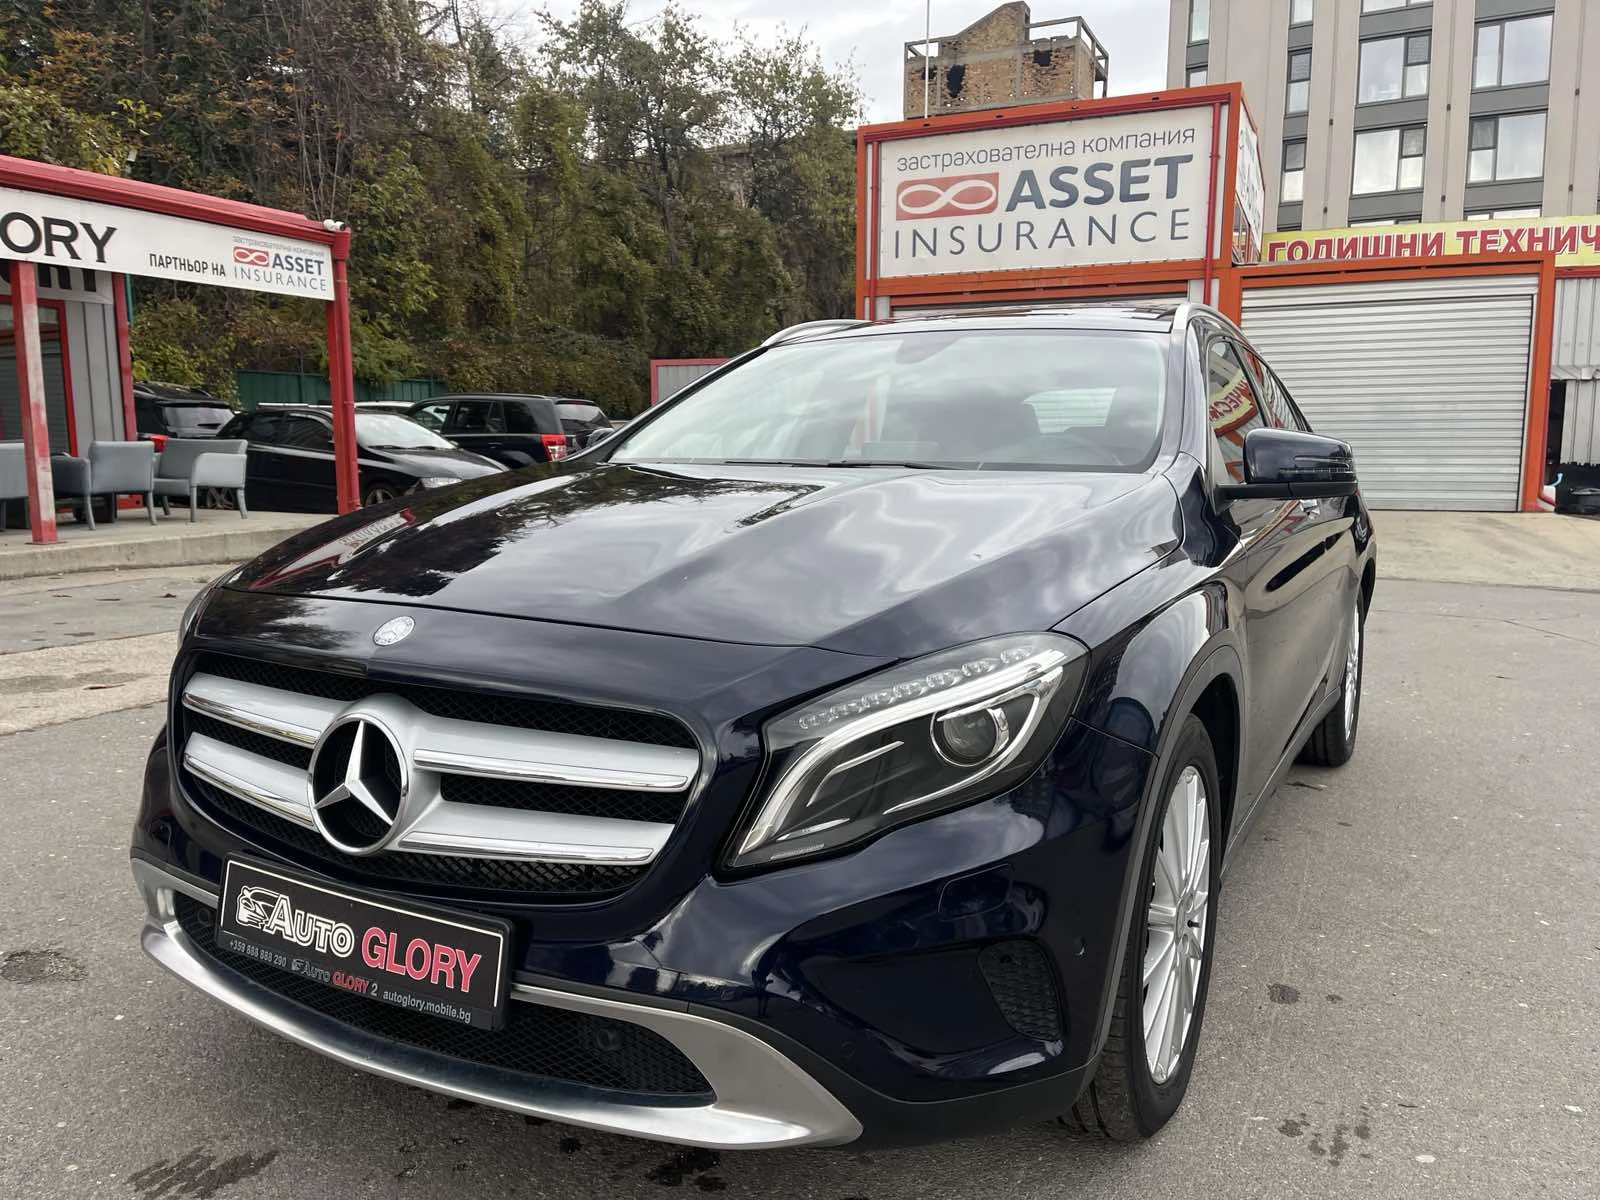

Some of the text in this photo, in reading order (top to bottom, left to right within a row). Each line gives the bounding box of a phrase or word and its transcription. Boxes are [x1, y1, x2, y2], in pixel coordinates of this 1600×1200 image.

[897, 128, 1195, 172] застрахователна компания
[1005, 154, 1194, 212] ASSET
[0, 212, 117, 263] ORY
[895, 208, 1190, 258] INSURANCE
[1268, 231, 1445, 261] ГОДИШНИ
[149, 253, 226, 276] ПАРТНЬОР НА
[234, 265, 326, 291] INSURANCE
[272, 253, 324, 275] ASSET
[361, 927, 481, 993] GLORY
[371, 983, 378, 996] 2
[383, 990, 471, 1024] autoglory.mobile.bg
